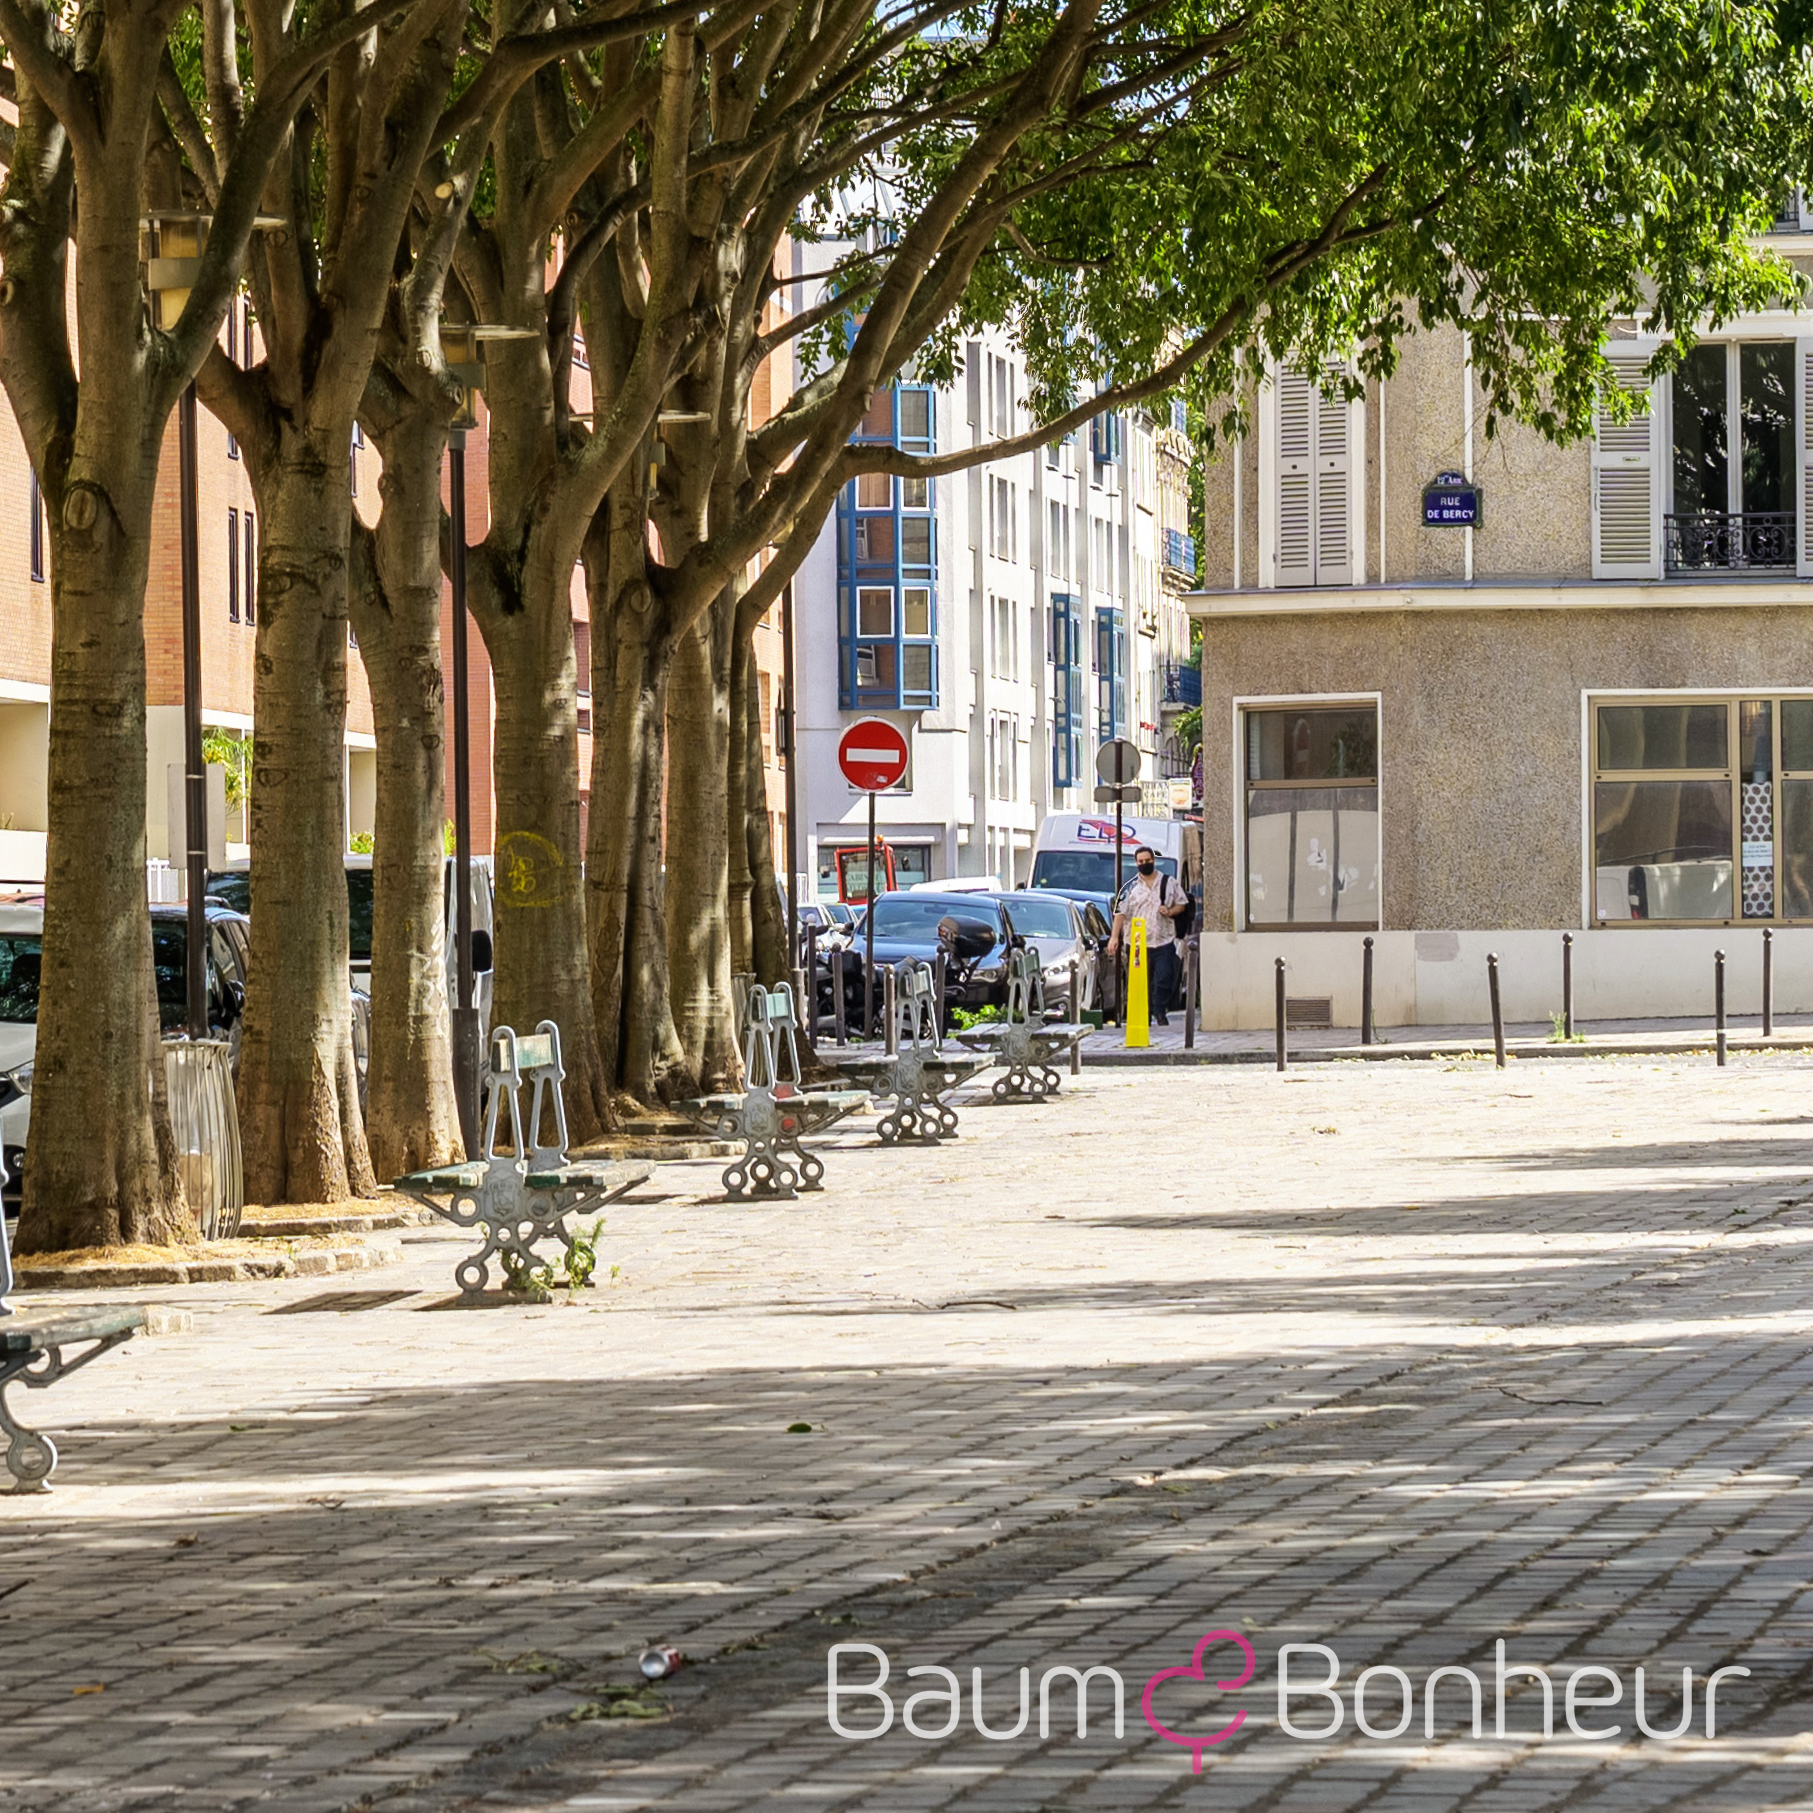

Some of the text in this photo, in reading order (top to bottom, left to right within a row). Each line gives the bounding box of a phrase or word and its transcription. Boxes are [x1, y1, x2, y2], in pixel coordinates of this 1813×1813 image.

[1440, 496, 1461, 506] RUE
[1426, 509, 1474, 519] DE BERCY
